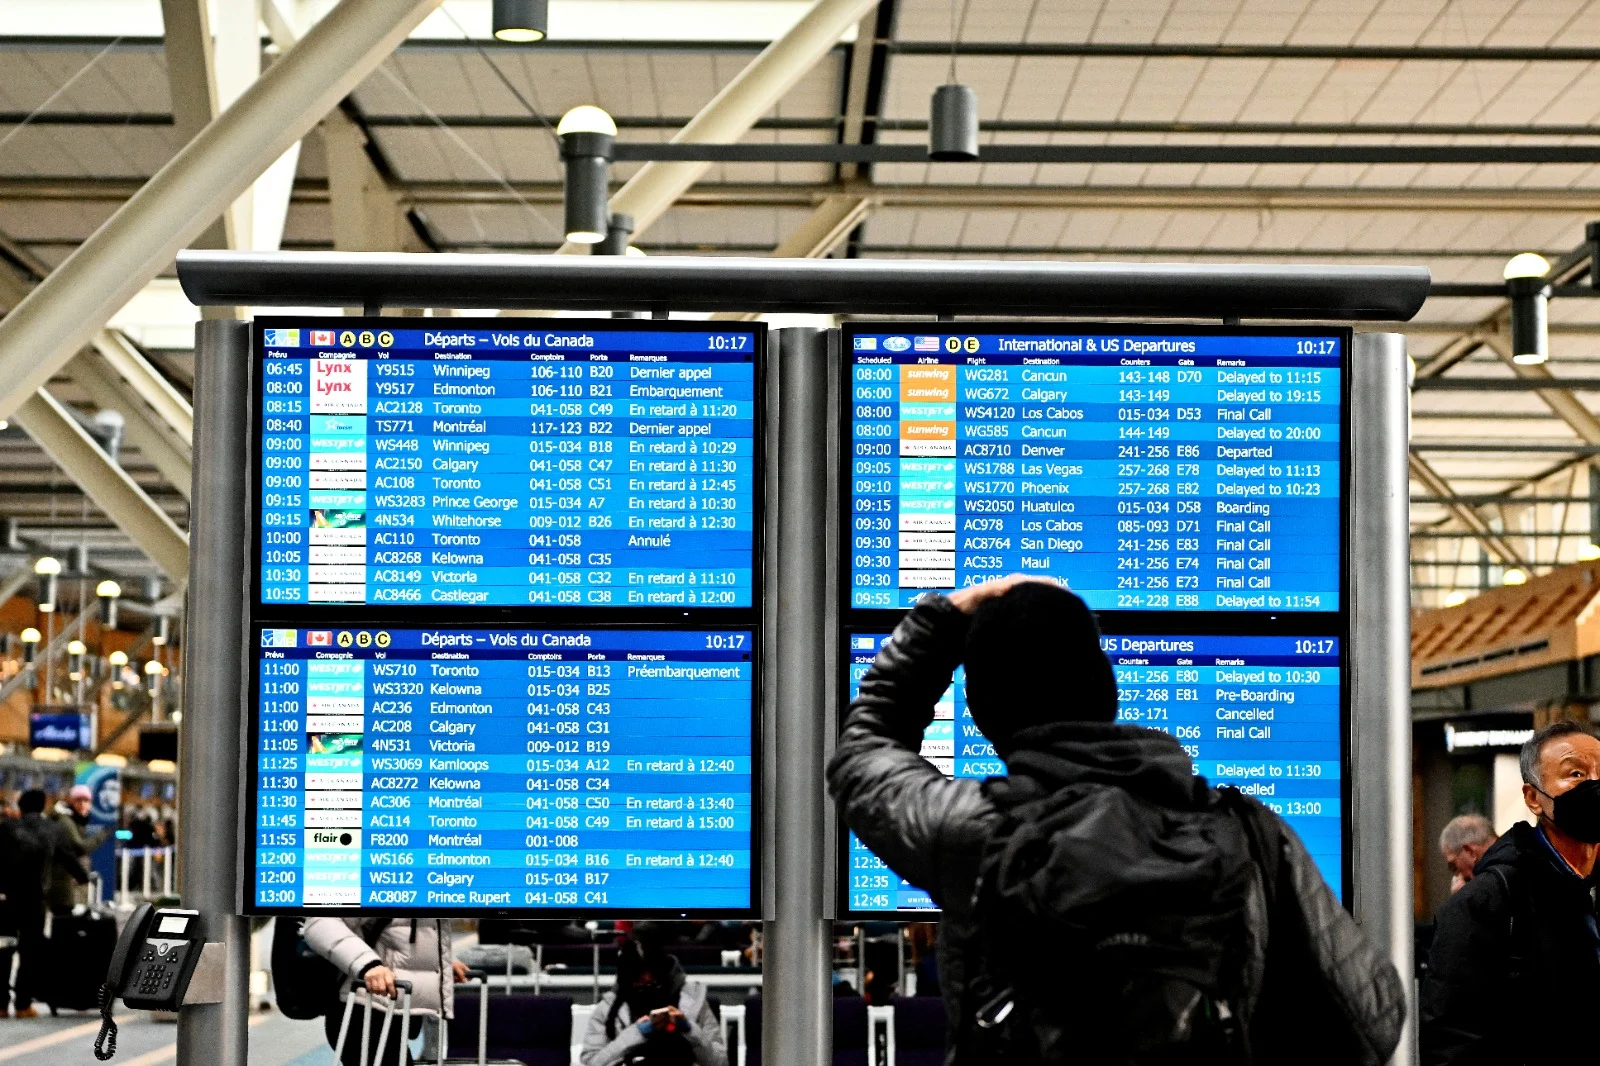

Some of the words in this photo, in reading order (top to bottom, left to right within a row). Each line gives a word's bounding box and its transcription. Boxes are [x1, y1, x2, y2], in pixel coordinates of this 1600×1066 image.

[343, 334, 352, 344] A
[363, 334, 371, 343] B
[380, 334, 390, 344] C
[425, 332, 475, 348] Départs
[492, 334, 519, 346] Vols
[524, 334, 540, 346] du
[545, 334, 593, 347] Canada
[709, 336, 746, 349] 10:17
[949, 340, 958, 350] D
[967, 340, 975, 350] E
[999, 339, 1082, 351] International
[1086, 339, 1097, 351] &
[1101, 339, 1119, 351] US
[1124, 340, 1195, 355] Departures
[1297, 341, 1335, 354] 10:17
[319, 352, 356, 360] Compagnie
[630, 354, 667, 362] Remarques
[267, 363, 302, 374] 06:45
[317, 361, 352, 376] Lynx
[376, 364, 414, 376] Y9515
[433, 365, 490, 379] Winnipeg
[532, 366, 582, 378] 106-110
[590, 366, 613, 378] B20
[631, 367, 675, 378] Dernier
[679, 367, 711, 381] appel
[857, 368, 891, 380] 08:00
[907, 369, 949, 380] sunwing
[965, 369, 1008, 381] WG281
[1022, 370, 1066, 381] Cancun
[1120, 371, 1170, 383] 143-148
[1178, 371, 1202, 382] D70
[1218, 371, 1265, 385] Delayed
[1270, 372, 1282, 383] to
[1288, 372, 1320, 383] 11:15
[267, 382, 302, 393] 08:00
[317, 379, 352, 395] Lynx
[376, 383, 414, 394] Y9517
[434, 383, 495, 395] Edmonton
[532, 385, 582, 396] 106-110
[590, 385, 612, 396] B21
[630, 385, 723, 399] Embarquement
[857, 444, 891, 455] 09:00
[965, 444, 1010, 455] AC8710
[1022, 444, 1065, 456] Denver
[1119, 446, 1169, 457] 241-256
[1177, 445, 1199, 457] E86
[1217, 446, 1272, 459] Departed
[266, 494, 301, 506] 09:15
[375, 495, 425, 507] WS3283
[433, 496, 470, 507] Prince
[474, 496, 518, 510] George
[530, 497, 581, 508] 015-034
[589, 498, 604, 508] A7
[629, 497, 644, 508] En
[649, 498, 685, 509] retard
[690, 497, 696, 509] à
[702, 498, 736, 509] 10:30
[856, 499, 890, 511] 09:15
[964, 500, 1014, 512] WS2050
[1022, 501, 1074, 512] Huatulco
[1118, 502, 1169, 513] 015-034
[1177, 502, 1201, 513] D58
[1217, 502, 1269, 516] Boarding
[267, 532, 301, 544] 10:00
[375, 533, 414, 544] AC110
[432, 534, 480, 545] Toronto
[529, 535, 581, 546] 041-058
[628, 534, 670, 546] Annulé
[856, 537, 891, 548] 09:30
[964, 537, 1010, 549] AC8764
[1021, 538, 1043, 549] San
[1048, 538, 1082, 552] Diego
[1118, 539, 1169, 550] 241-256
[1177, 539, 1199, 550] E83
[1217, 539, 1244, 550] Final
[1249, 539, 1270, 550] Call
[706, 635, 744, 648] 10:17
[1100, 639, 1117, 651] US
[1122, 639, 1193, 654] Departures
[1296, 640, 1333, 653] 10:17
[265, 664, 299, 675] 11:00
[373, 664, 416, 676] WS710
[431, 664, 479, 676] Toronto
[528, 666, 580, 677] 015-034
[588, 665, 610, 677] B13
[628, 664, 740, 680] Préembarquement
[1117, 671, 1168, 682] 241-256
[1177, 670, 1198, 682] E80
[1216, 671, 1264, 684] Delayed
[1269, 672, 1281, 682] to
[1287, 671, 1320, 683] 10:30
[1117, 689, 1168, 701] 257-268
[1177, 689, 1198, 700] E81
[1216, 689, 1294, 703] Pre-Boarding
[1118, 708, 1167, 720] 163-171
[1216, 708, 1273, 720] Cancelled
[1217, 727, 1244, 738] Final
[1249, 727, 1270, 738] Call
[264, 739, 297, 750] 11:05
[372, 740, 410, 751] 4N531
[430, 740, 475, 751] Victoria
[528, 741, 579, 752] 009-012
[587, 740, 610, 752] B19
[263, 758, 297, 769] 11:25
[372, 758, 422, 769] WS3069
[430, 759, 488, 772] Kamloops
[527, 760, 579, 771] 015-034
[586, 760, 609, 770] A12
[963, 763, 1001, 774] AC552
[1217, 764, 1265, 778] Delayed
[1269, 765, 1282, 776] to
[1287, 765, 1321, 776] 11:30
[262, 834, 296, 845] 11:55
[314, 833, 338, 842] flair
[371, 834, 408, 845] F8200
[429, 833, 481, 846] Montréal
[526, 835, 578, 847] 001-008
[261, 853, 296, 864] 12:00
[370, 853, 413, 864] WS166
[428, 853, 490, 865] Edmonton
[526, 854, 578, 866] 015-034
[586, 854, 609, 865] B16
[627, 854, 641, 865] En
[646, 855, 682, 866] retard
[687, 851, 694, 866] à
[700, 854, 733, 866] 12:40
[261, 890, 295, 902] 13:00
[369, 891, 417, 902] AC8087
[428, 891, 465, 902] Prince
[470, 892, 510, 905] Rupert
[526, 892, 577, 904] 041-058
[585, 892, 607, 903] C41
[854, 894, 888, 906] 12:45
